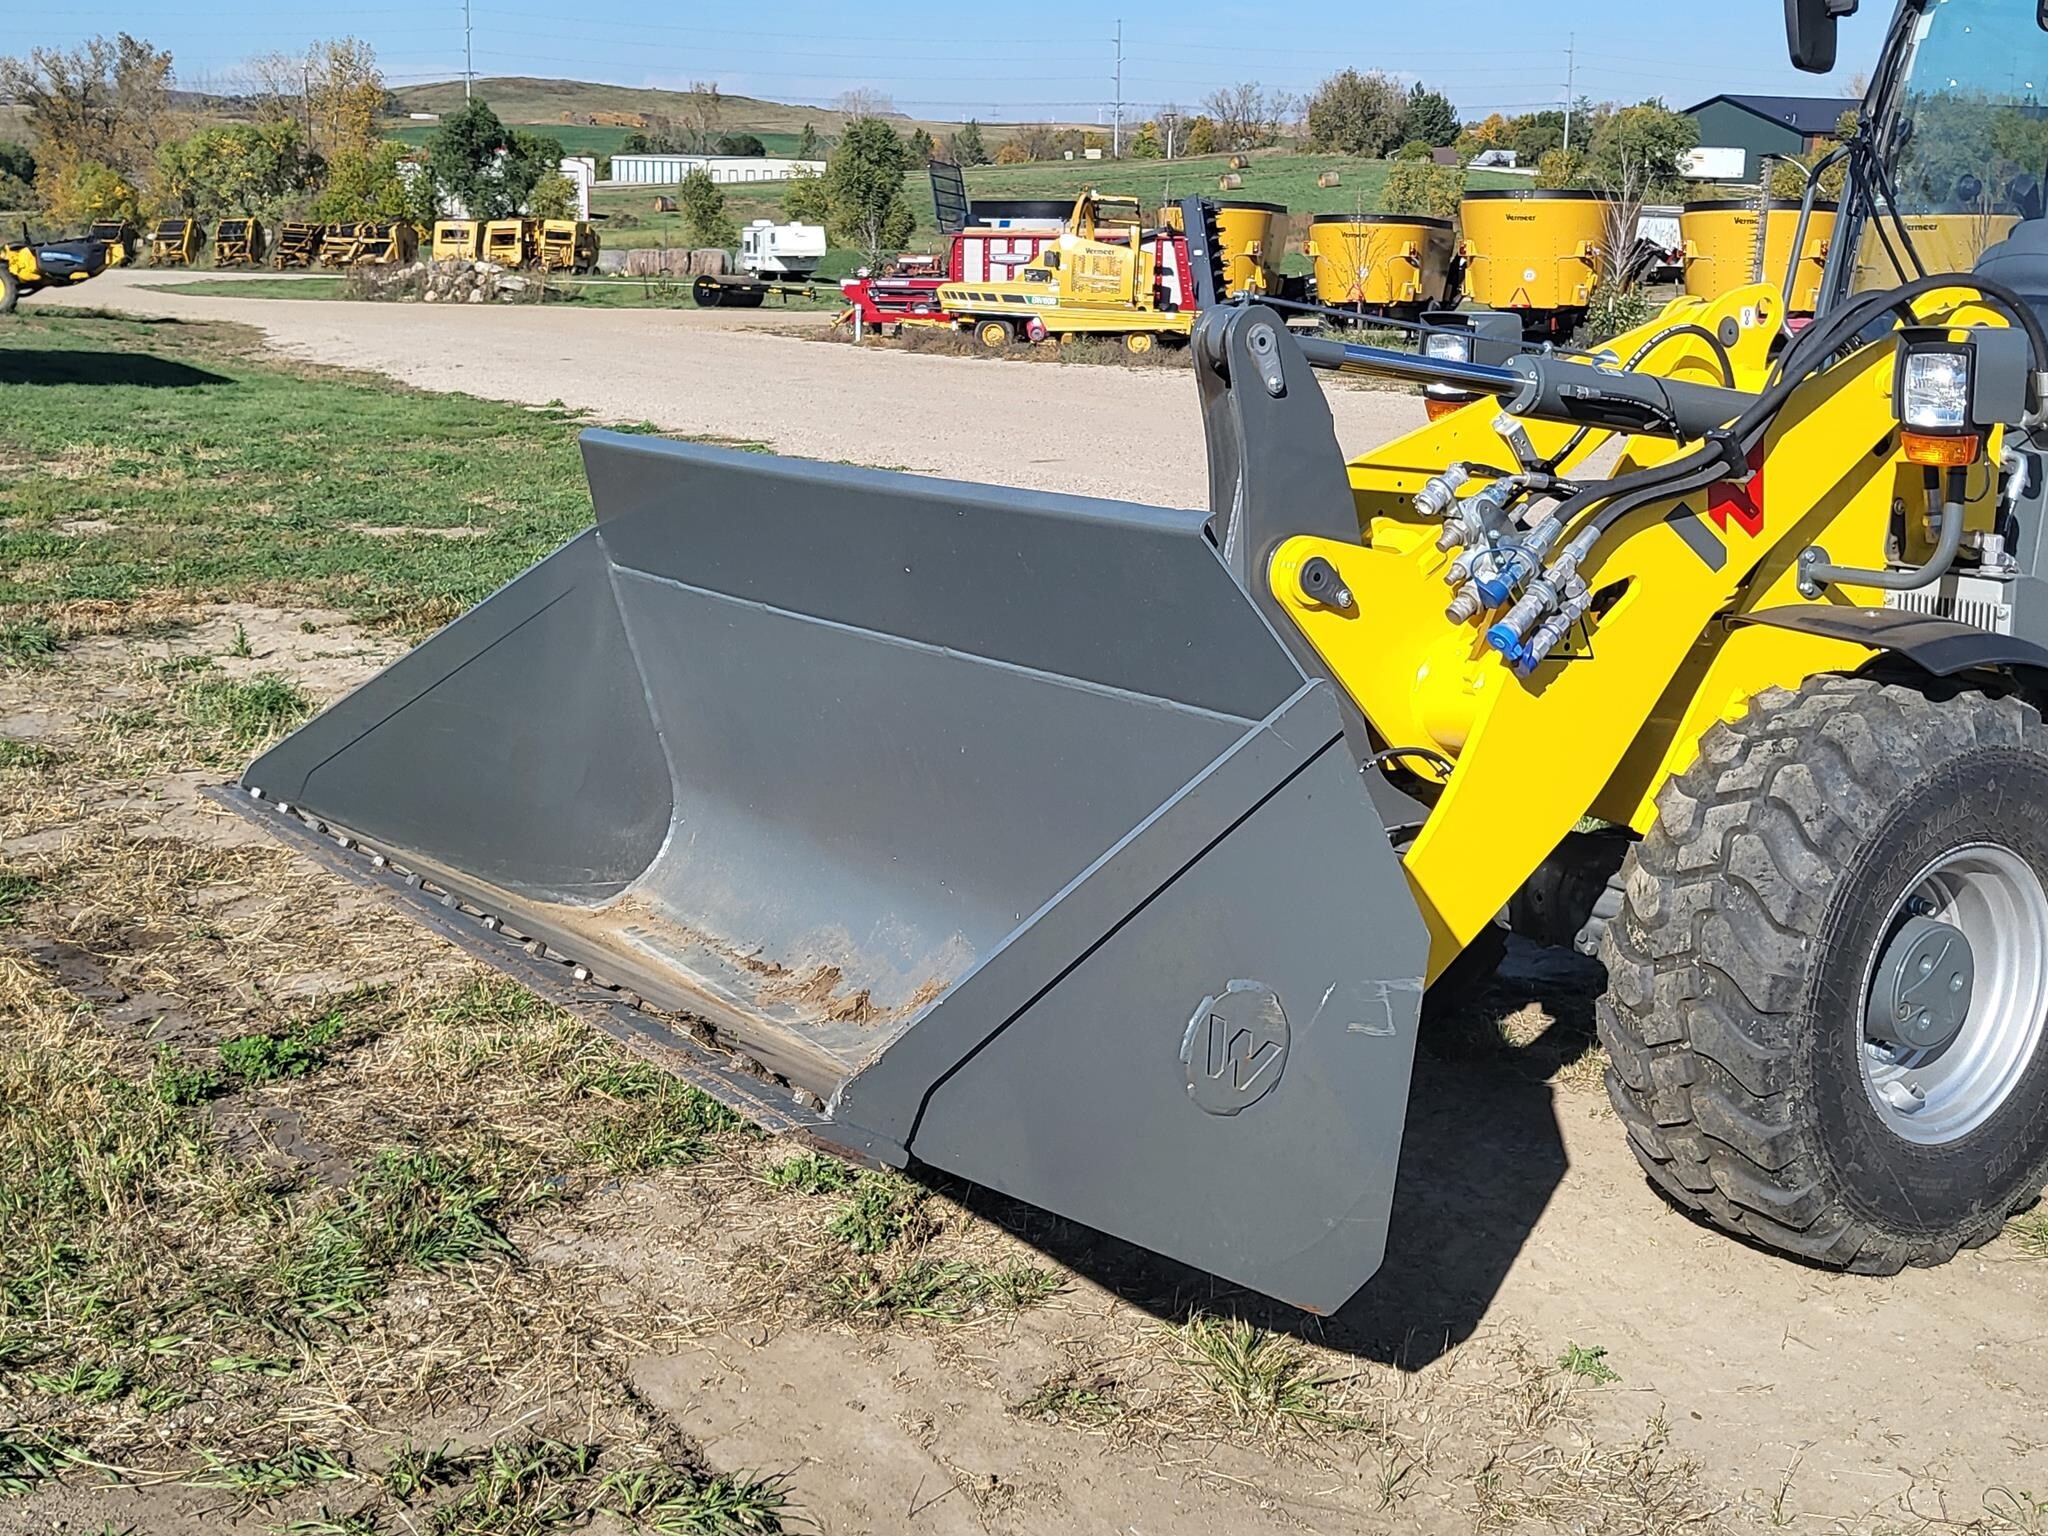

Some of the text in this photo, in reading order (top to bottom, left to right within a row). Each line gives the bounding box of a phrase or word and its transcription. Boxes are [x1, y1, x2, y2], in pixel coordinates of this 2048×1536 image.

[1505, 213, 1536, 221] Vermeer
[1734, 216, 1759, 225] Verme
[1904, 223, 1938, 231] ermeer
[1085, 247, 1115, 255] Vermeer
